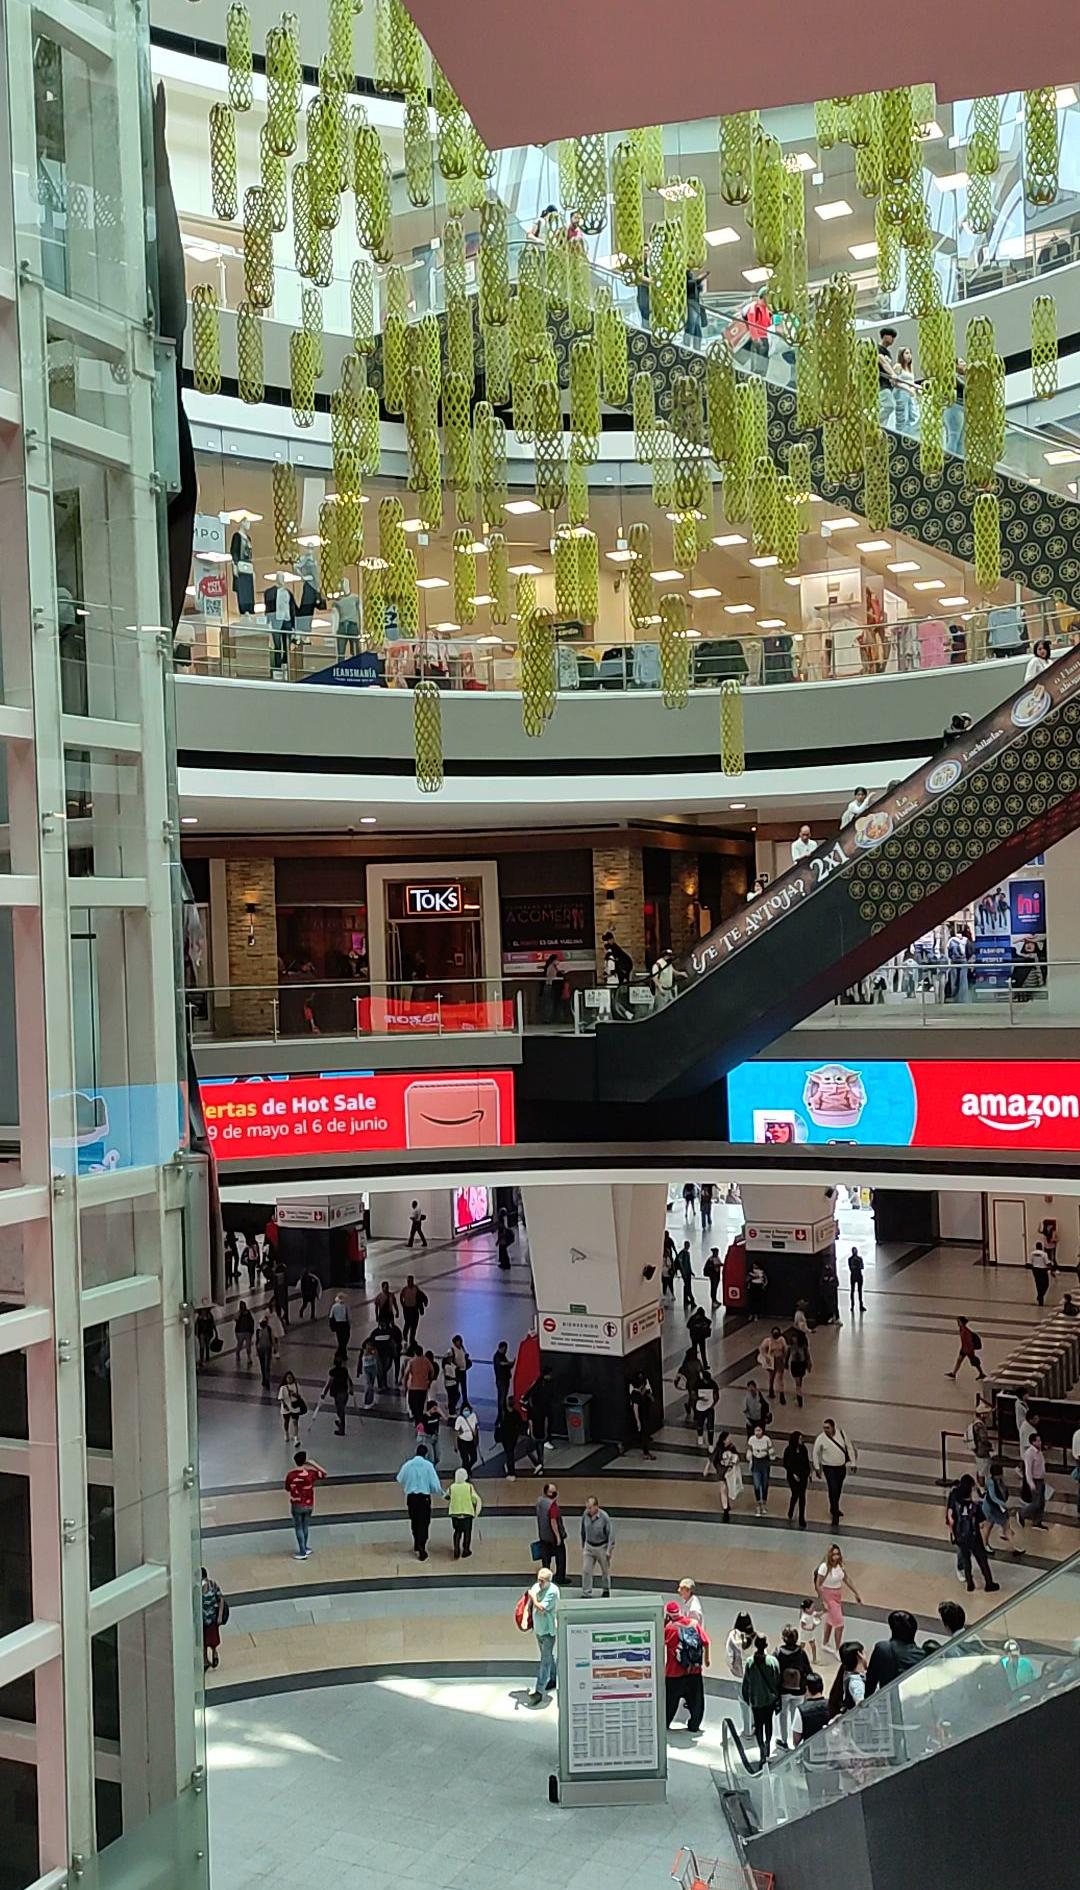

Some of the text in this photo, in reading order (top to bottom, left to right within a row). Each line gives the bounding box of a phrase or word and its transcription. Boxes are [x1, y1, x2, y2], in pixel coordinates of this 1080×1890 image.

[809, 841, 850, 883] 2x1
[719, 927, 742, 952] TE
[745, 879, 807, 936] ANTOJA?
[1017, 892, 1041, 914] hi
[202, 1093, 377, 1119] ertas de Hot Sale
[961, 1093, 1079, 1118] amazon
[222, 1123, 242, 1139] de
[247, 1122, 289, 1140] mayo
[294, 1119, 307, 1135] al
[312, 1118, 323, 1133] 6
[327, 1116, 346, 1132] de
[348, 1116, 388, 1135] junio
